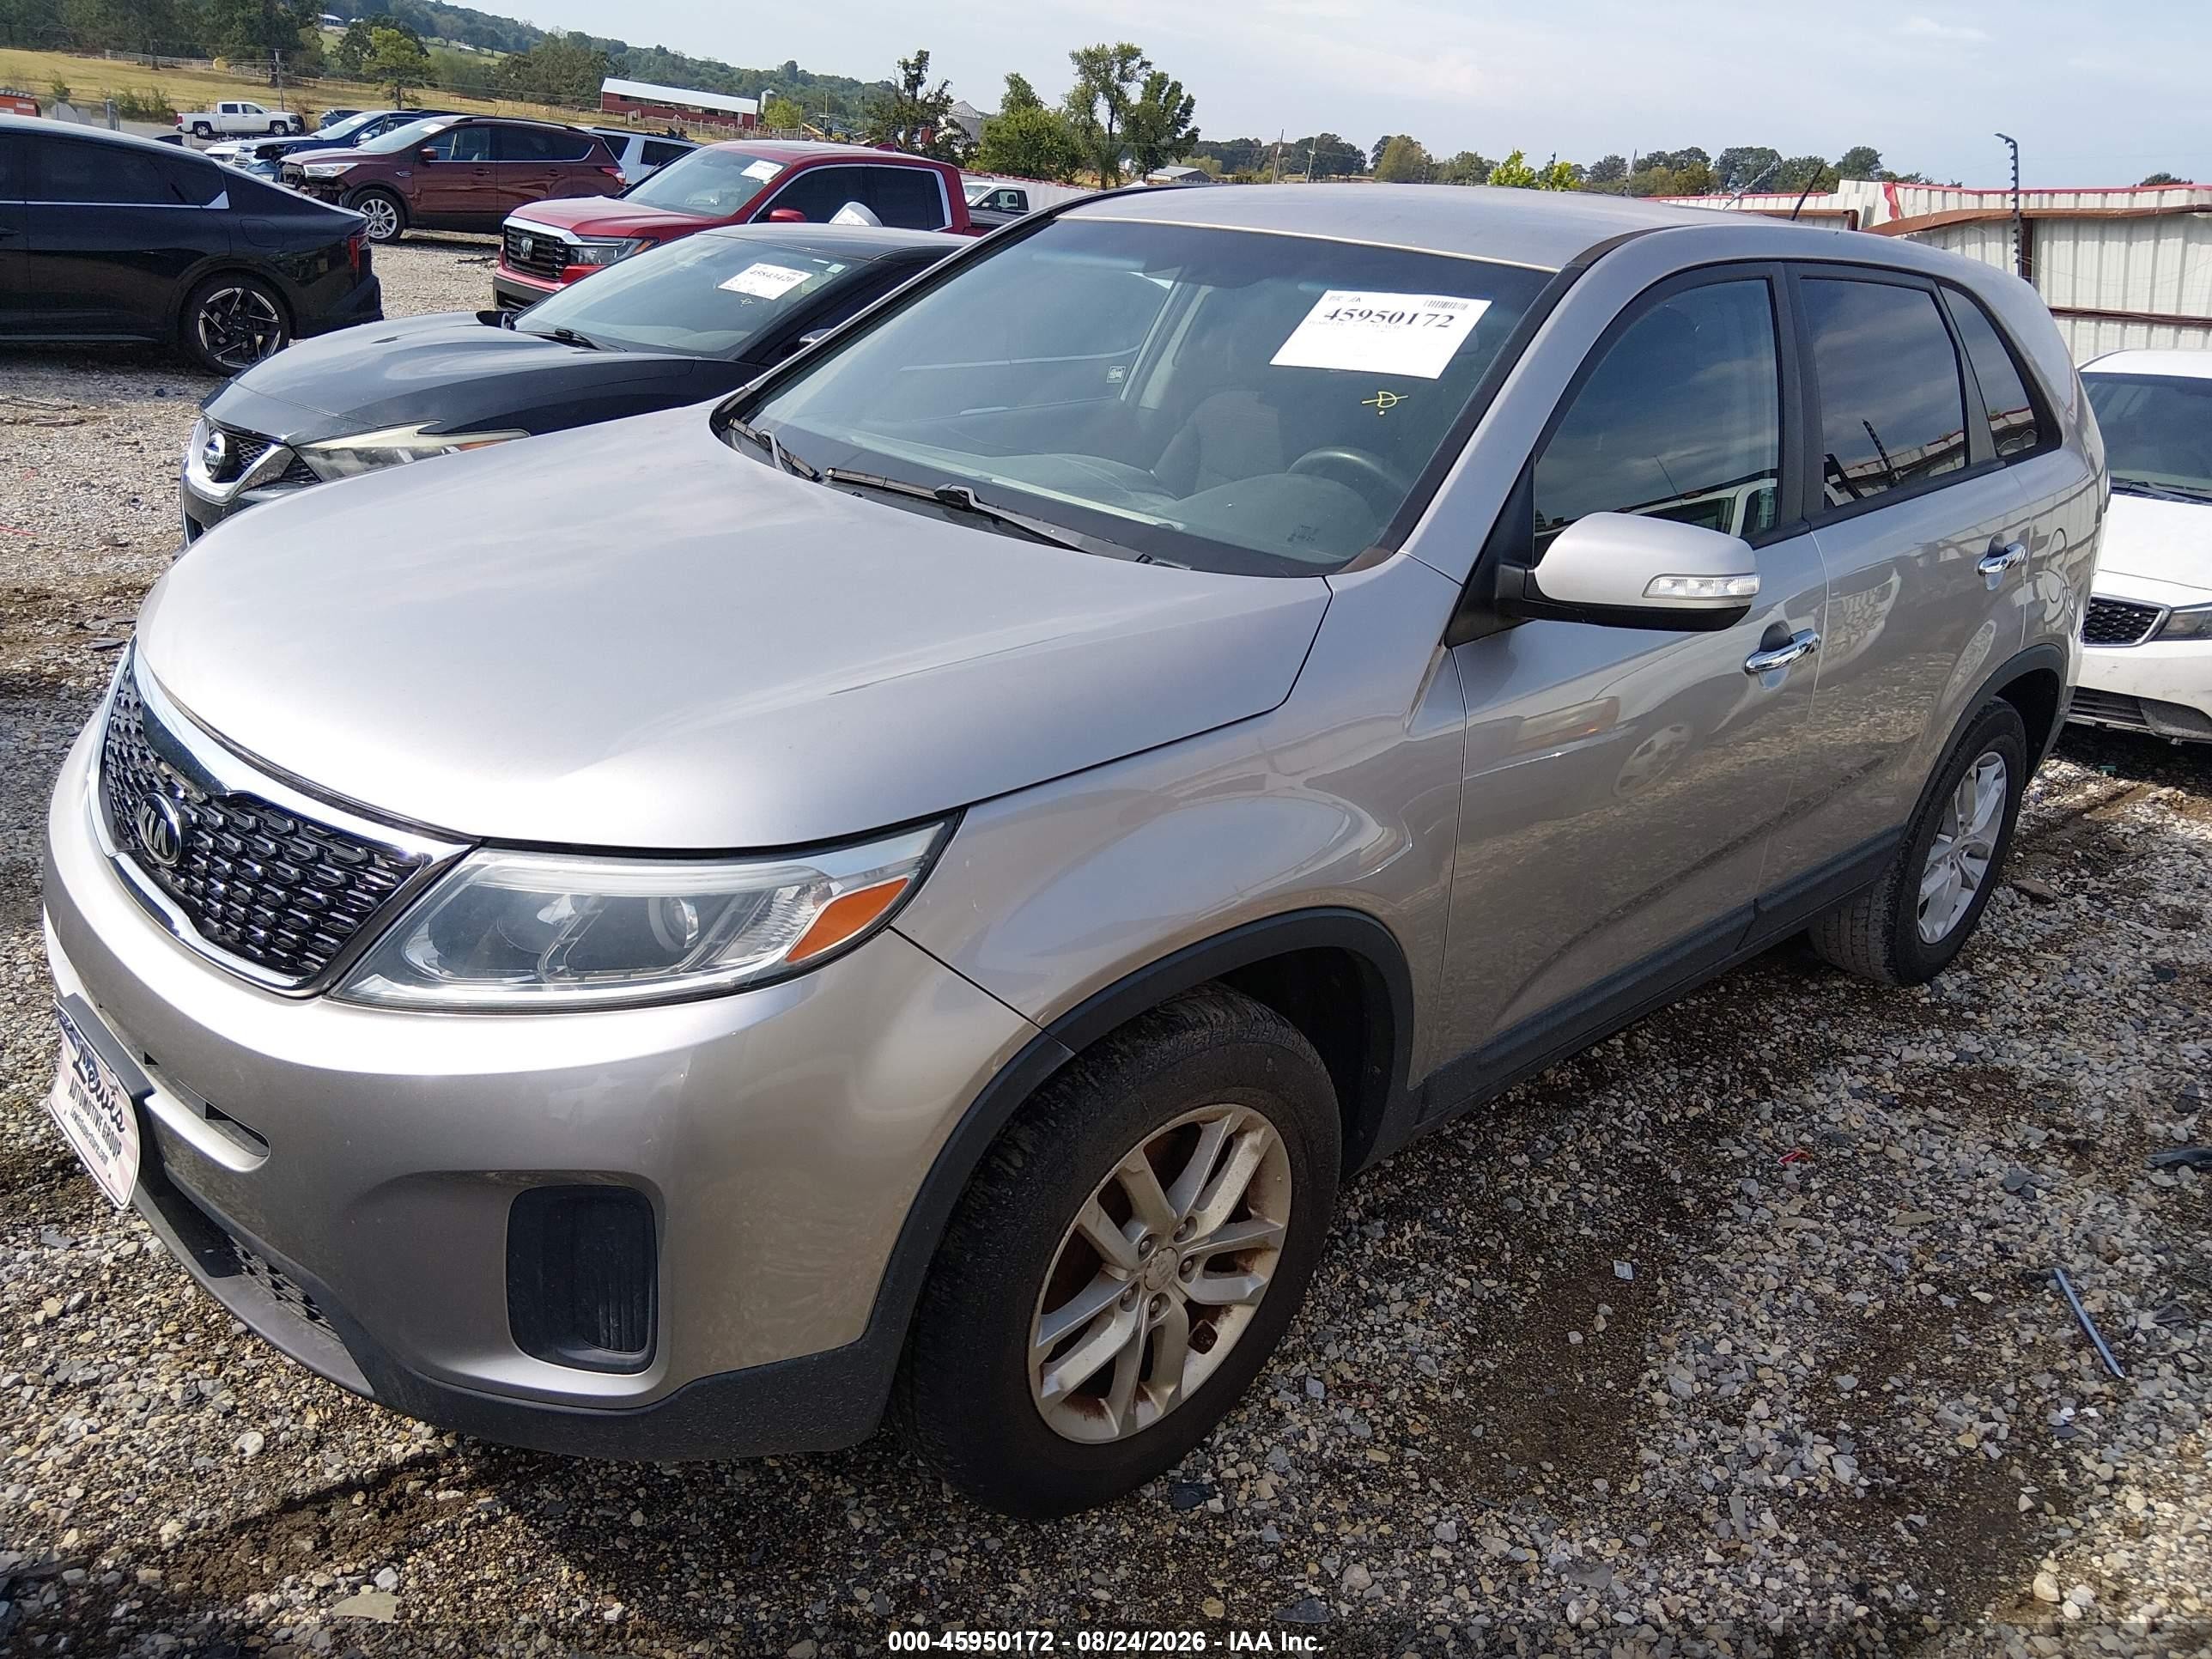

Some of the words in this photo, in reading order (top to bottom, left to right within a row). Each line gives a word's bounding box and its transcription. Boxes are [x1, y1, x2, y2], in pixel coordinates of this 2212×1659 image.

[1323, 307, 1455, 328] 45950172
[68, 1076, 104, 1133] AUTOMOTIVE
[101, 1121, 123, 1162] GROUP
